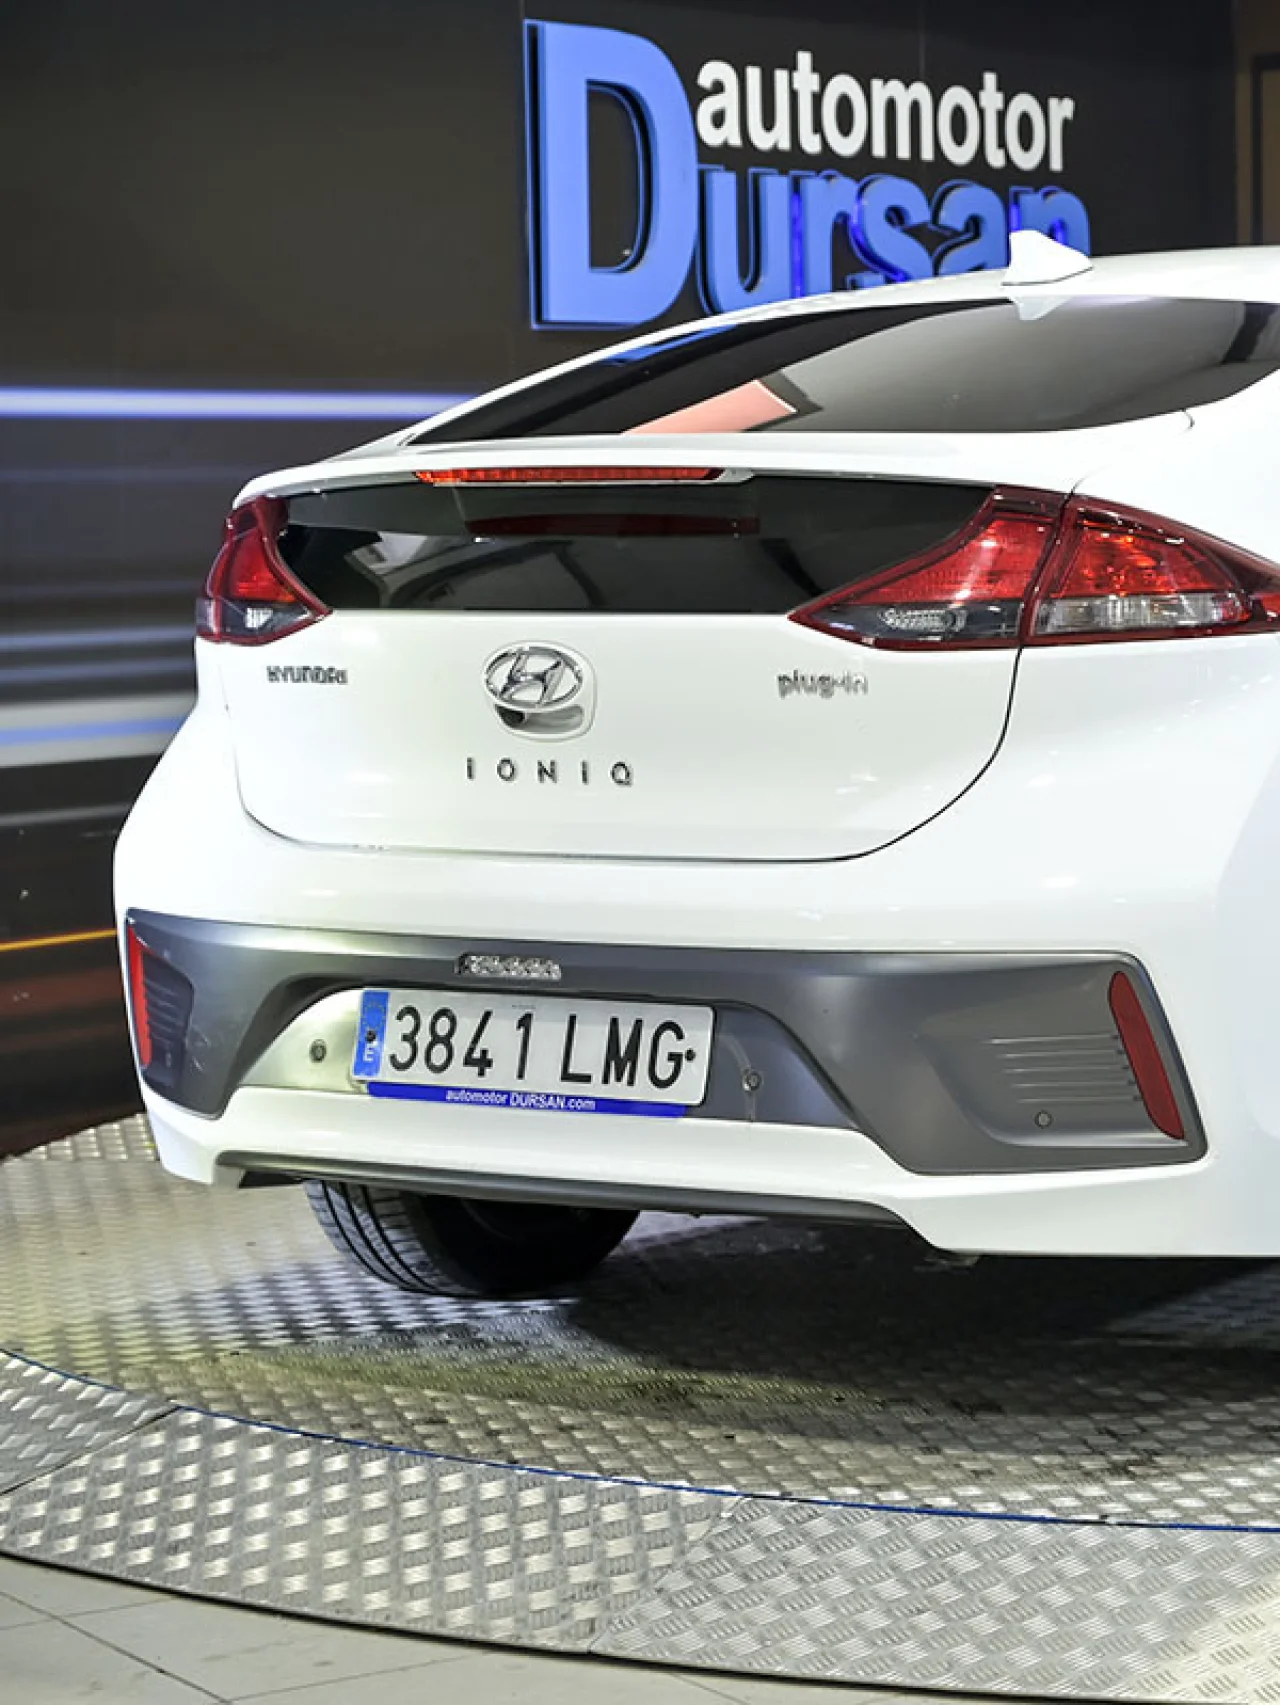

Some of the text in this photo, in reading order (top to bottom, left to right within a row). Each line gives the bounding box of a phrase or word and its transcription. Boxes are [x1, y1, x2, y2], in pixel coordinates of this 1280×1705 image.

[697, 51, 1074, 171] automotor
[266, 665, 348, 685] HYUNDAI
[466, 757, 633, 787] IONIQ
[389, 1005, 685, 1089] 3841 LMG
[445, 1089, 596, 1111] automotor DURSAN.com
